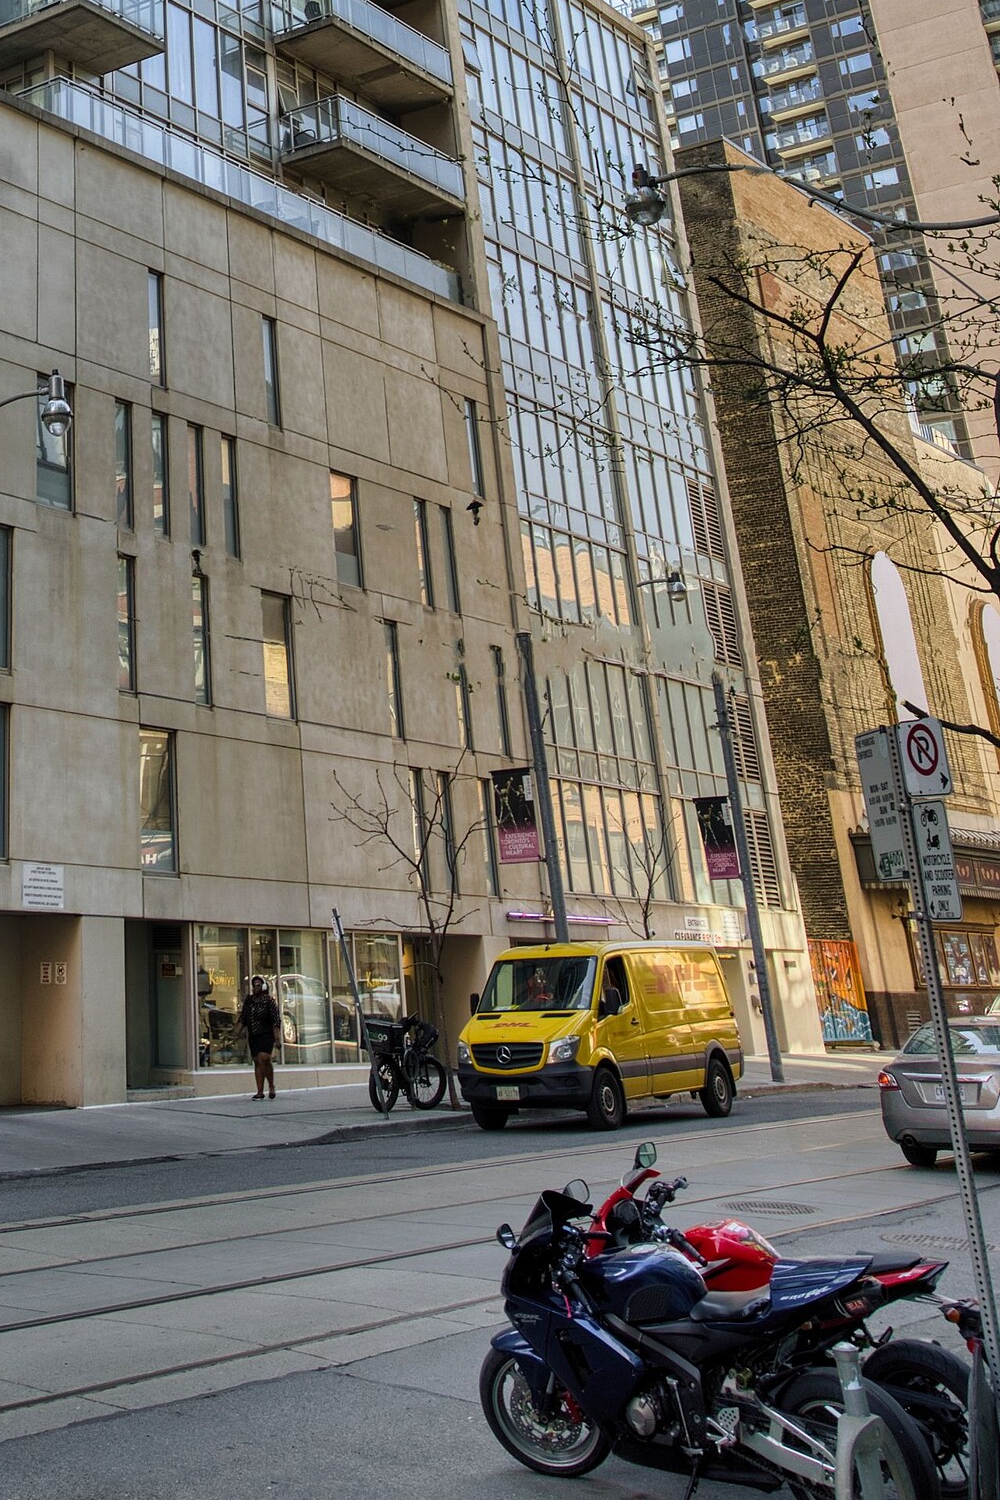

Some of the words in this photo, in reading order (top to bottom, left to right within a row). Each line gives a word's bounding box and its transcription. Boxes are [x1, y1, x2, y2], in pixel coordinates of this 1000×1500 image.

[504, 832, 537, 840] EXPERIENCE
[922, 853, 952, 866] MOTORCYCLE
[924, 869, 934, 881] AND
[934, 868, 954, 881] SCOOTER
[932, 884, 952, 896] PARKING
[938, 900, 950, 911] ONLY
[687, 918, 707, 927] ENTRANCE
[653, 963, 708, 993] DHL
